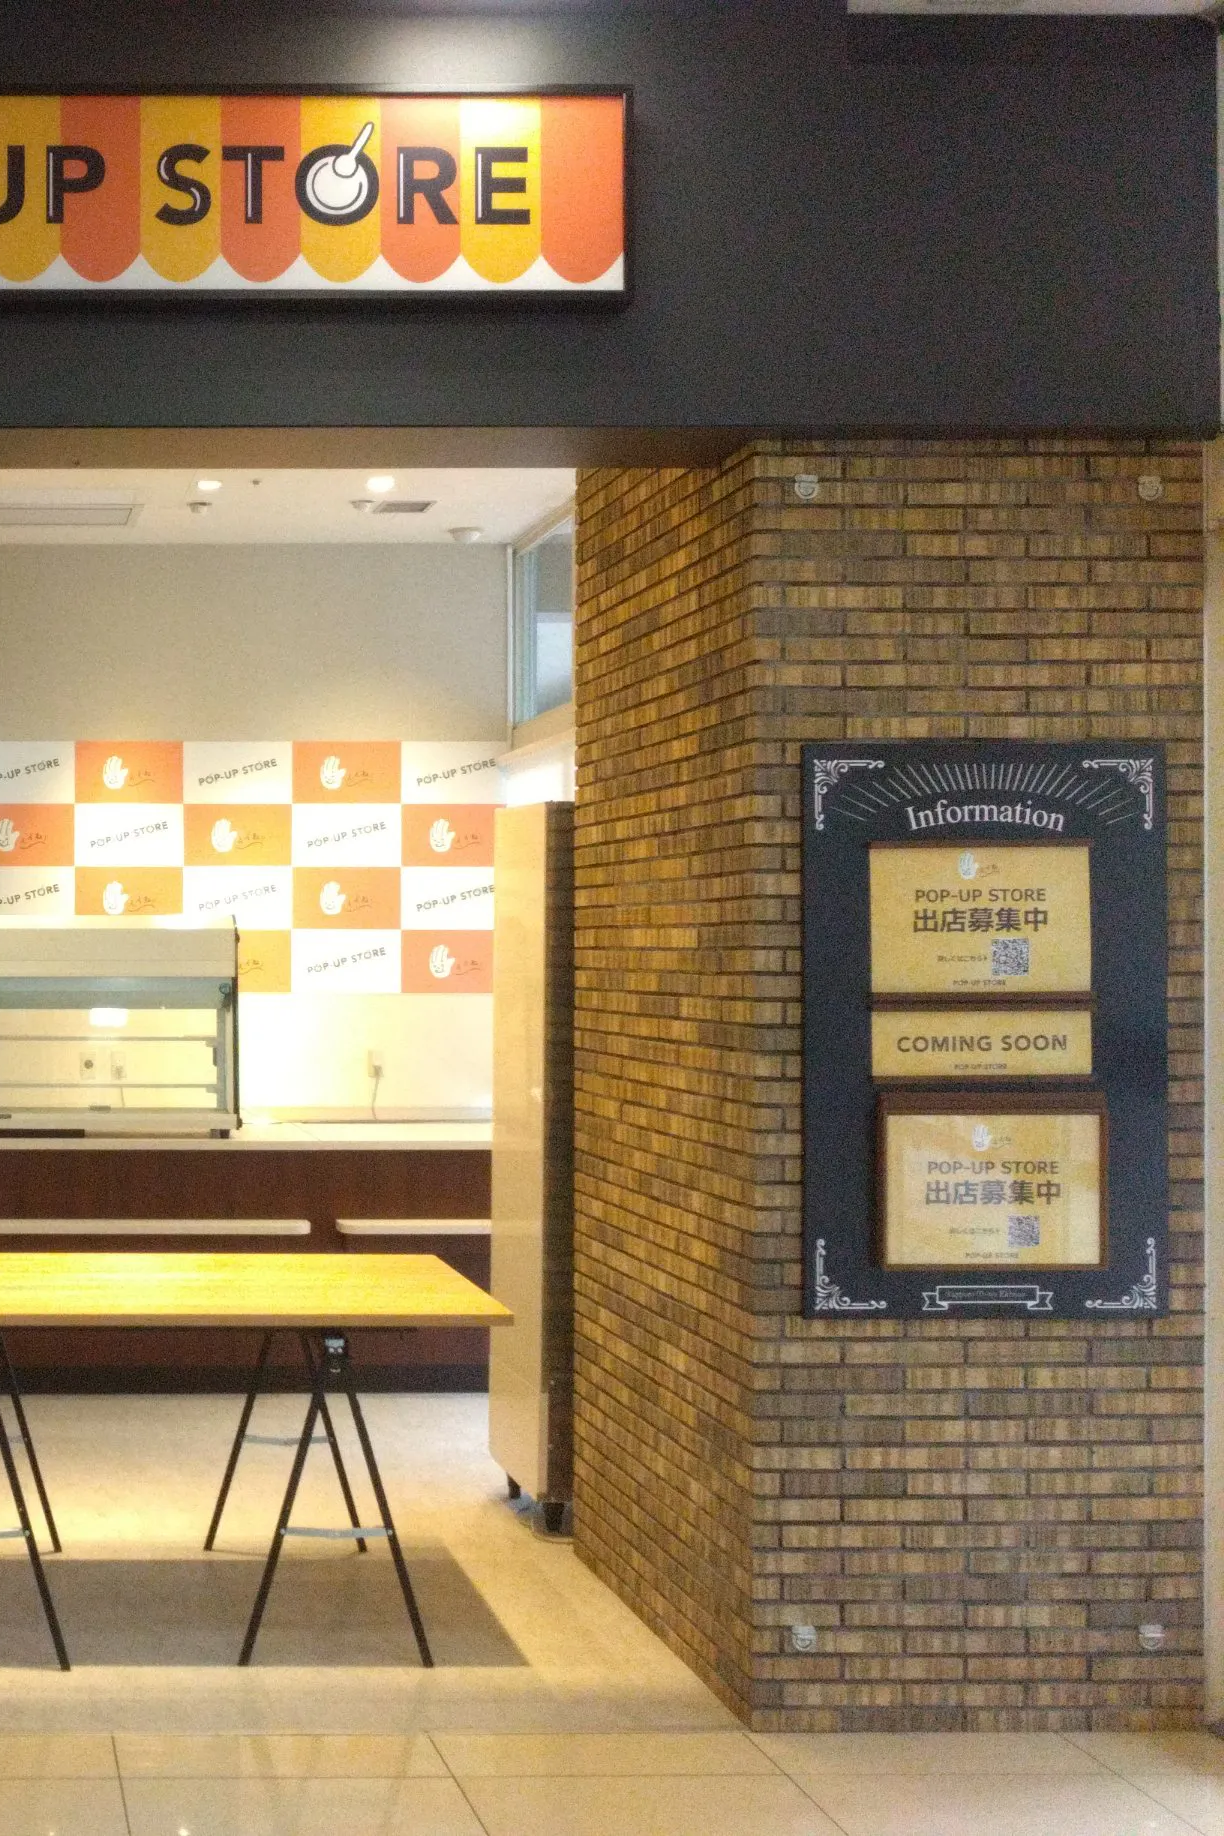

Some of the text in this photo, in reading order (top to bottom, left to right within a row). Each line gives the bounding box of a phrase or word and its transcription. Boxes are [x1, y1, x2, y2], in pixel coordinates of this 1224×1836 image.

[154, 143, 531, 226] STORE
[25, 758, 60, 774] STORE
[198, 758, 277, 786] POP-UP STORE
[417, 758, 497, 786] POP-UP STORE
[905, 800, 1065, 832] Information
[90, 831, 129, 848] POPUP
[307, 832, 347, 848] POPUP
[25, 884, 60, 900] STORE
[460, 884, 495, 901] STORE
[915, 888, 1046, 903] POP-UP STORE
[198, 894, 238, 912] POPUP
[913, 908, 1048, 933] 出店募集中
[897, 1034, 1067, 1053] COMING SOON
[927, 1161, 1060, 1175] POP-UP STORE
[926, 1180, 1061, 1205] 出店募集中
